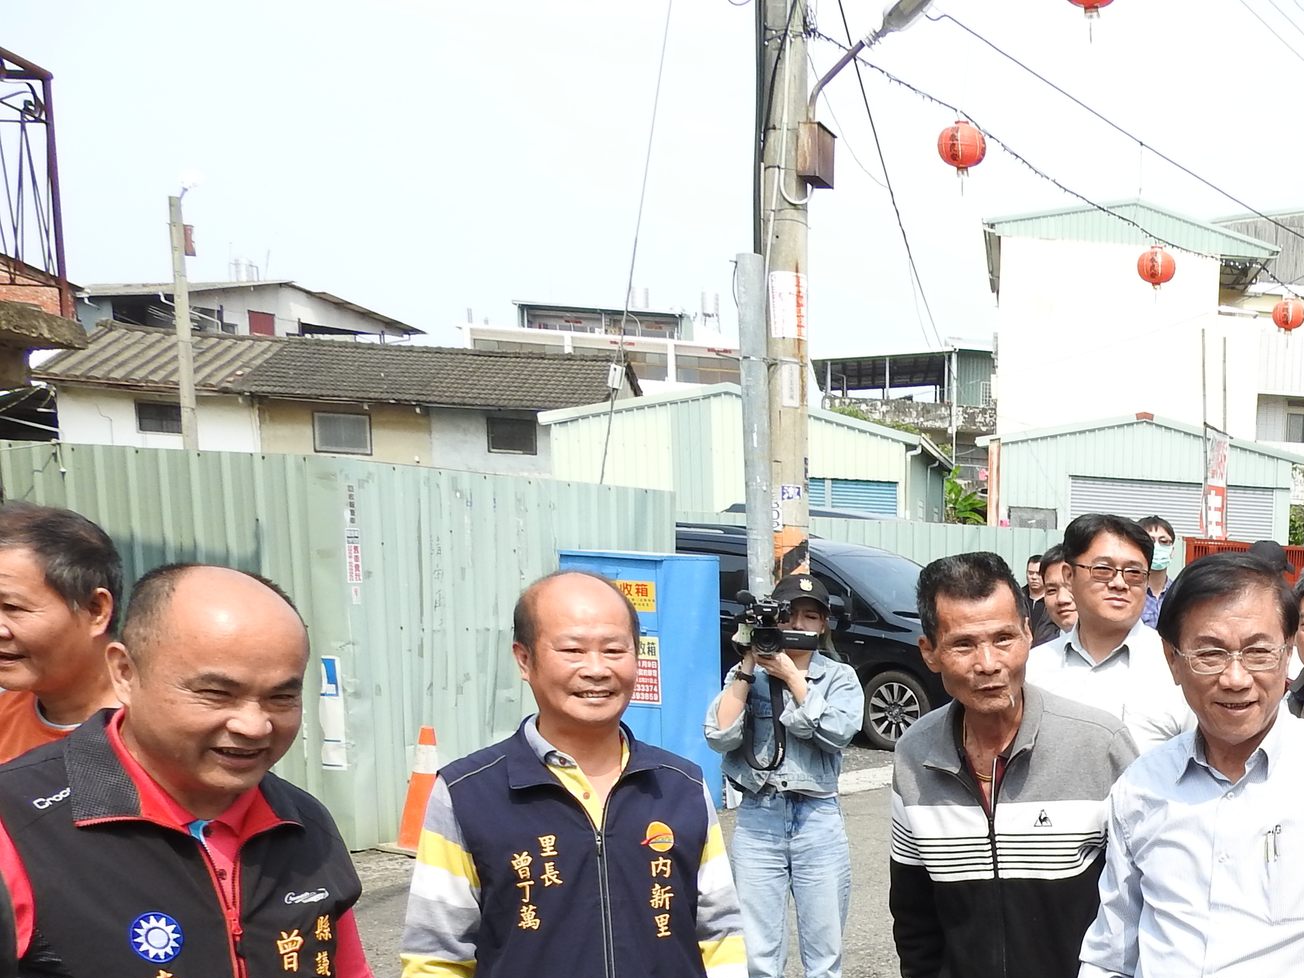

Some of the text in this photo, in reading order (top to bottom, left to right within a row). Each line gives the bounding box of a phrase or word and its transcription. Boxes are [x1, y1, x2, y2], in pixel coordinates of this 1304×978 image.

[511, 851, 541, 931] 曾丁萬
[538, 834, 563, 887] 里長
